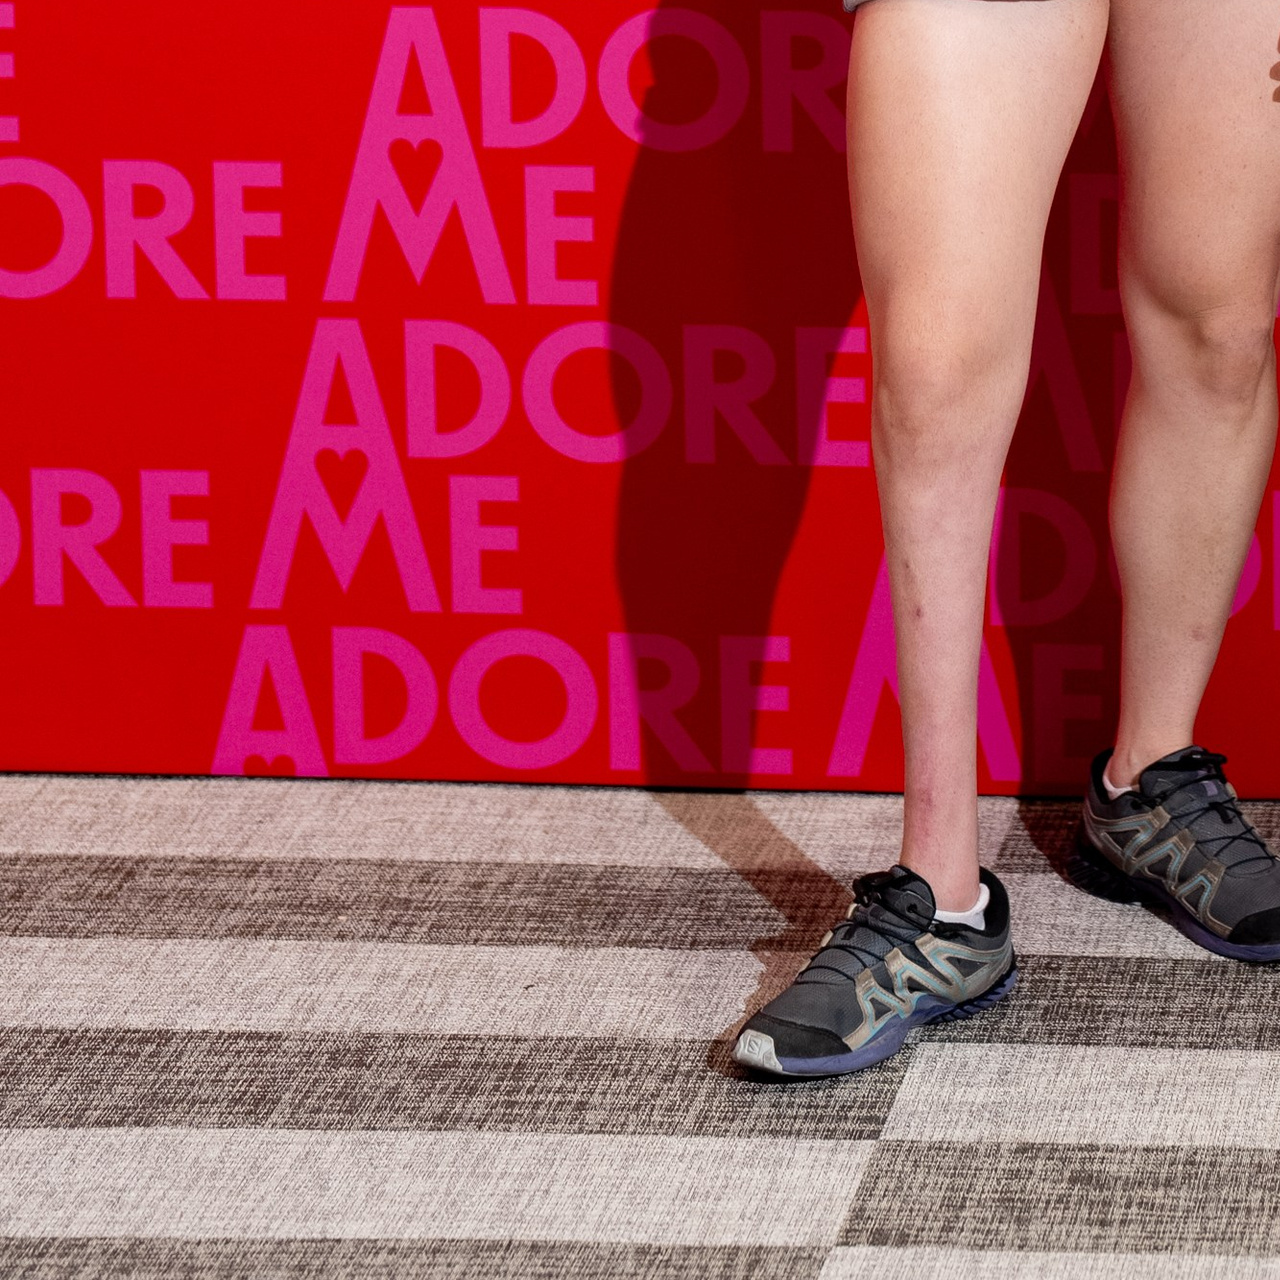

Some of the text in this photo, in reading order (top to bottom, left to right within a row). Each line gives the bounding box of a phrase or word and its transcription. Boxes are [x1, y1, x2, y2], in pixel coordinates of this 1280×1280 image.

[358, 5, 850, 150] ADOR
[0, 156, 287, 301] ORE
[322, 140, 599, 306] ME
[284, 317, 870, 467] ADORE
[249, 450, 523, 614] ME
[211, 624, 796, 776] ADORE
